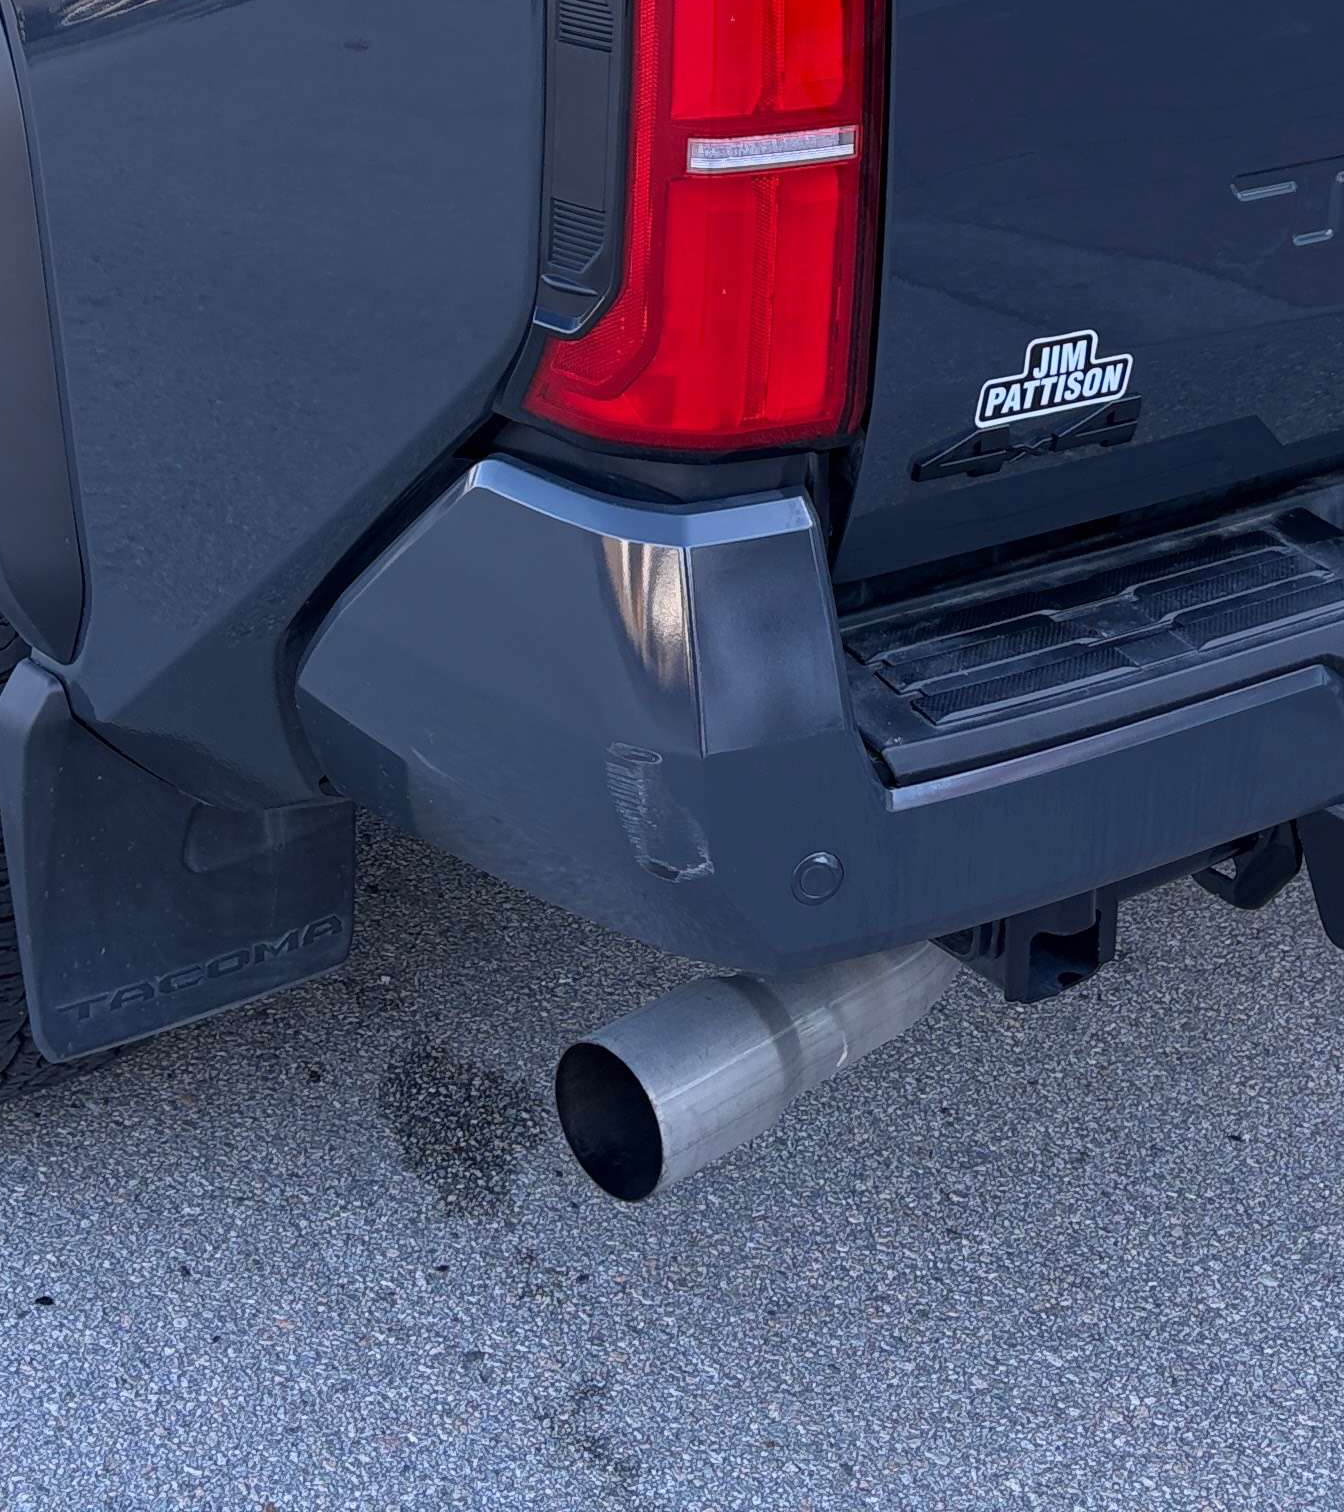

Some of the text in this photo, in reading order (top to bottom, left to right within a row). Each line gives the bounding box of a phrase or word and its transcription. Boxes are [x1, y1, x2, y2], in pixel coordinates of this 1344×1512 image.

[1032, 339, 1087, 380] JIM
[984, 362, 1124, 418] PATTISON
[56, 913, 346, 1022] TACOMA
